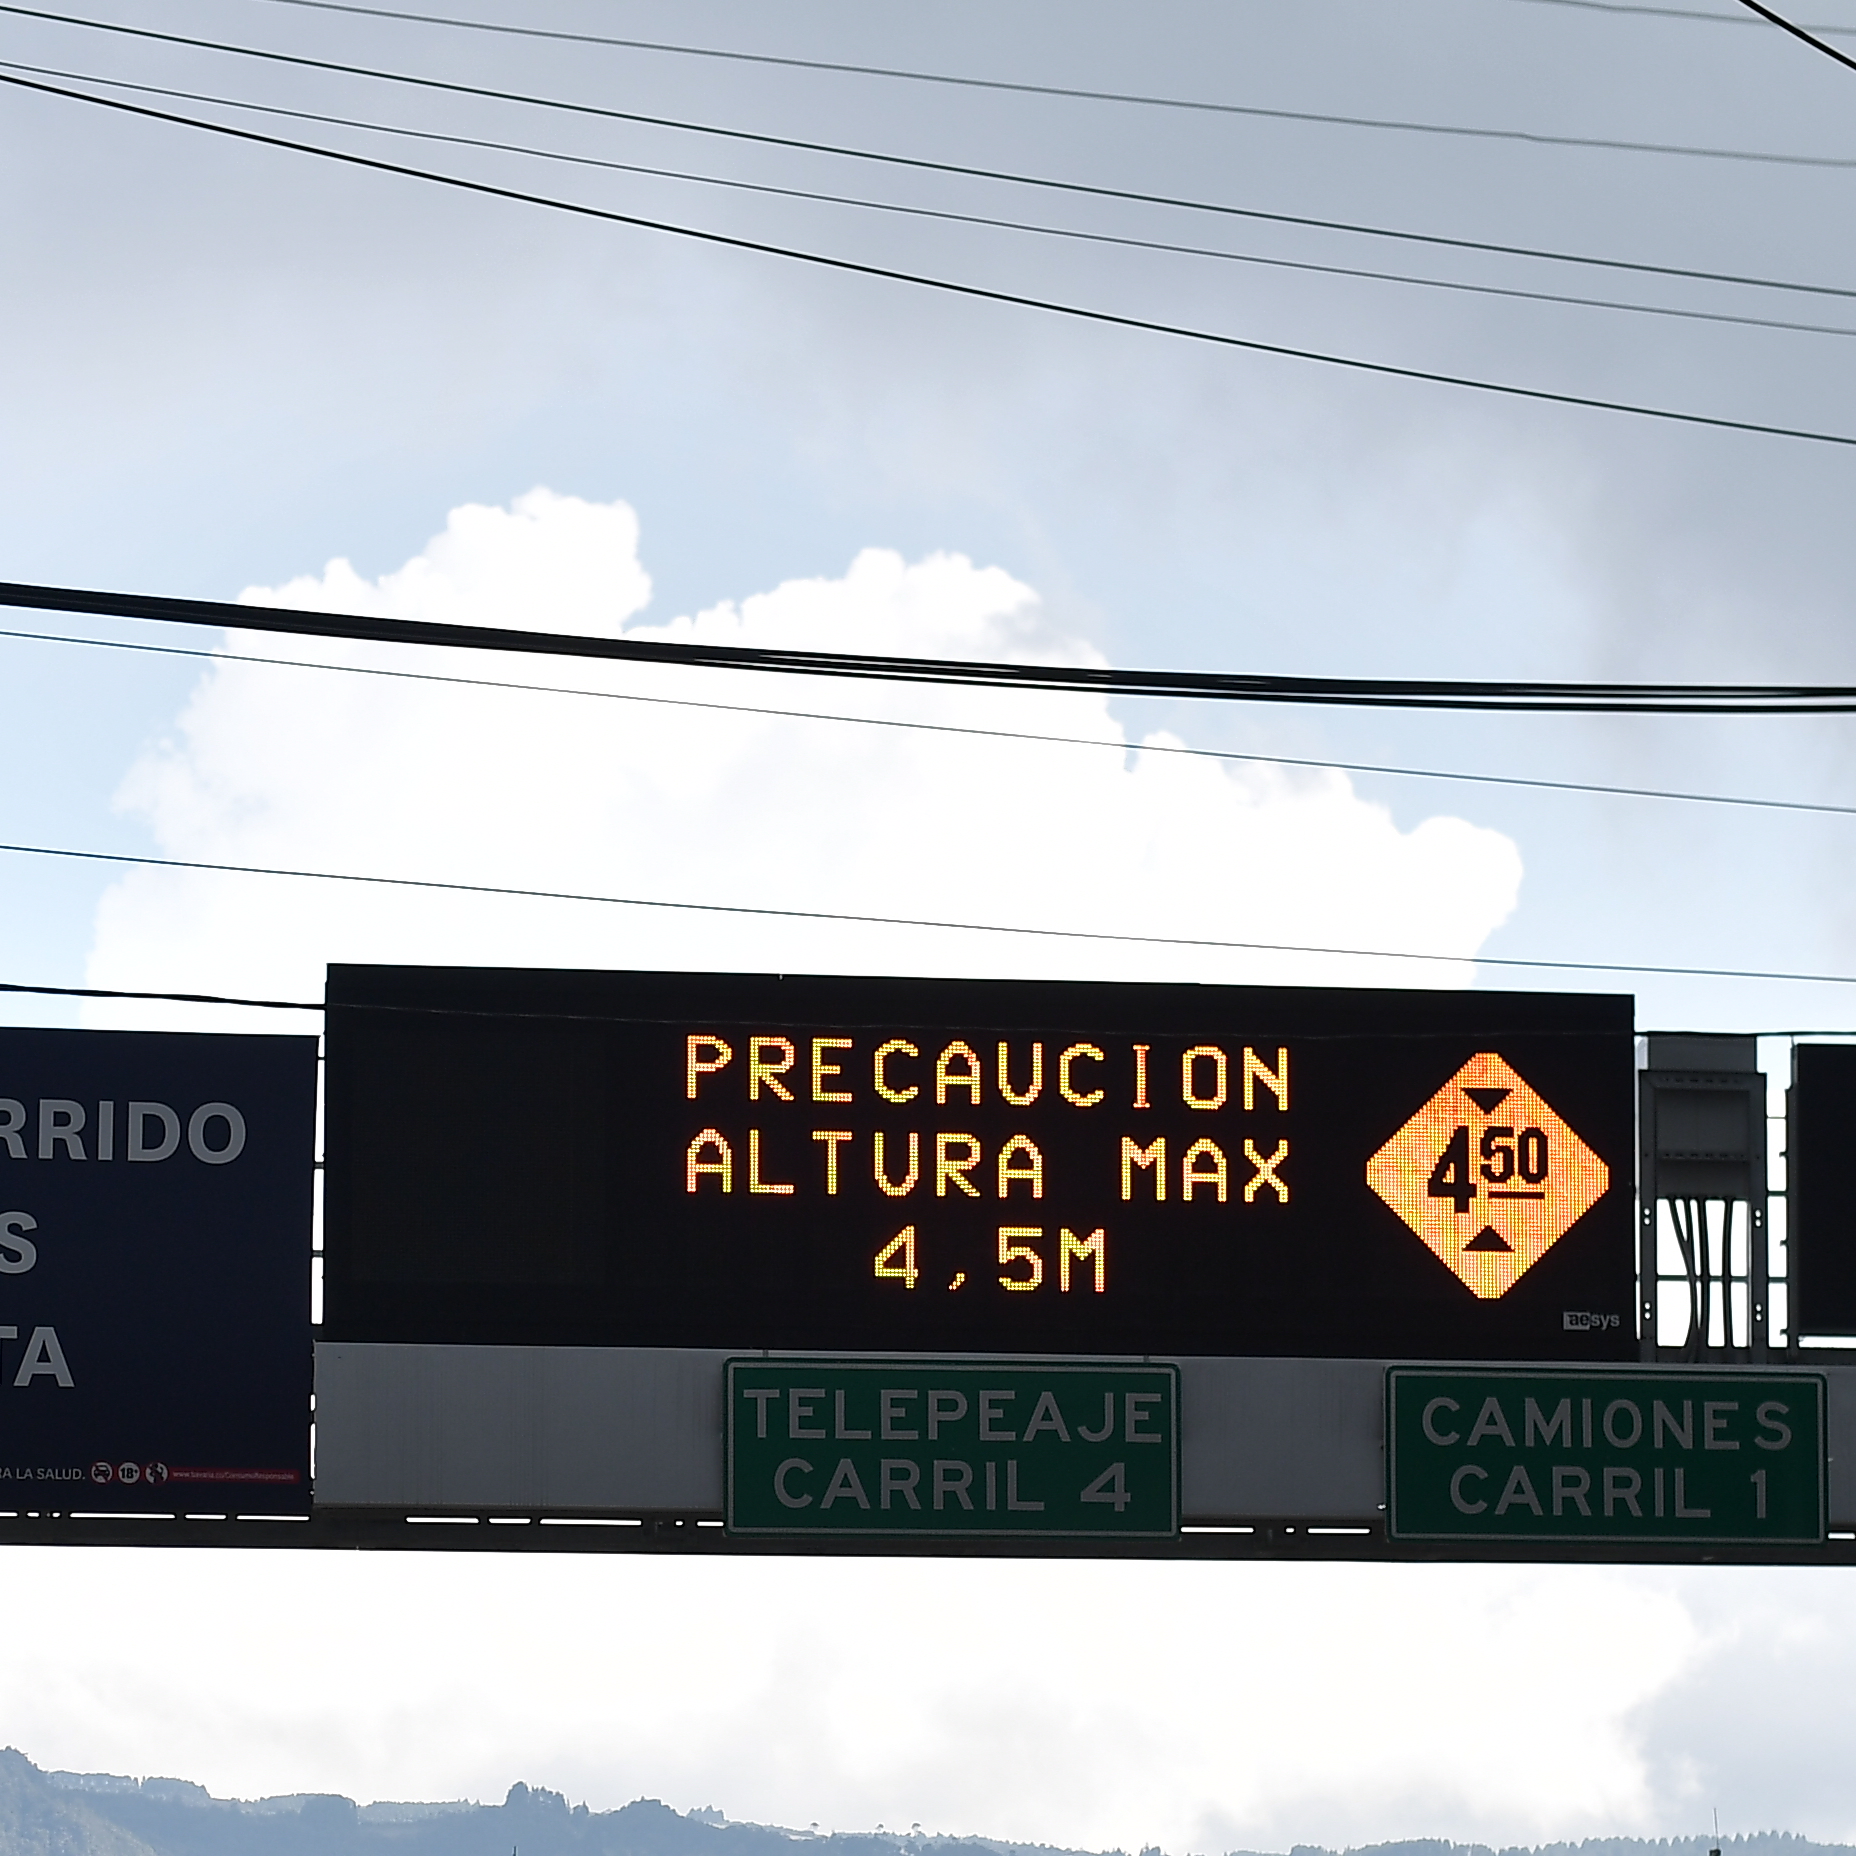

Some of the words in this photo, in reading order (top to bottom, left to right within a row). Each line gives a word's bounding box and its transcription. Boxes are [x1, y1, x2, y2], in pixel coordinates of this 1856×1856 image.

[686, 1034, 1289, 1112] PRECAUCION
[686, 1128, 1044, 1200] ALTURA
[1121, 1136, 1289, 1204] MAX
[743, 1386, 1162, 1443] TELEPEAJE
[1421, 1396, 1793, 1453] CAMIONES
[16, 1466, 33, 1480] LA
[37, 1467, 86, 1481] SALUD.
[772, 1458, 1045, 1512] CARRIL
[1080, 1462, 1132, 1511] 4
[1448, 1463, 1712, 1520] CARRIL
[1749, 1469, 1769, 1520] 1
